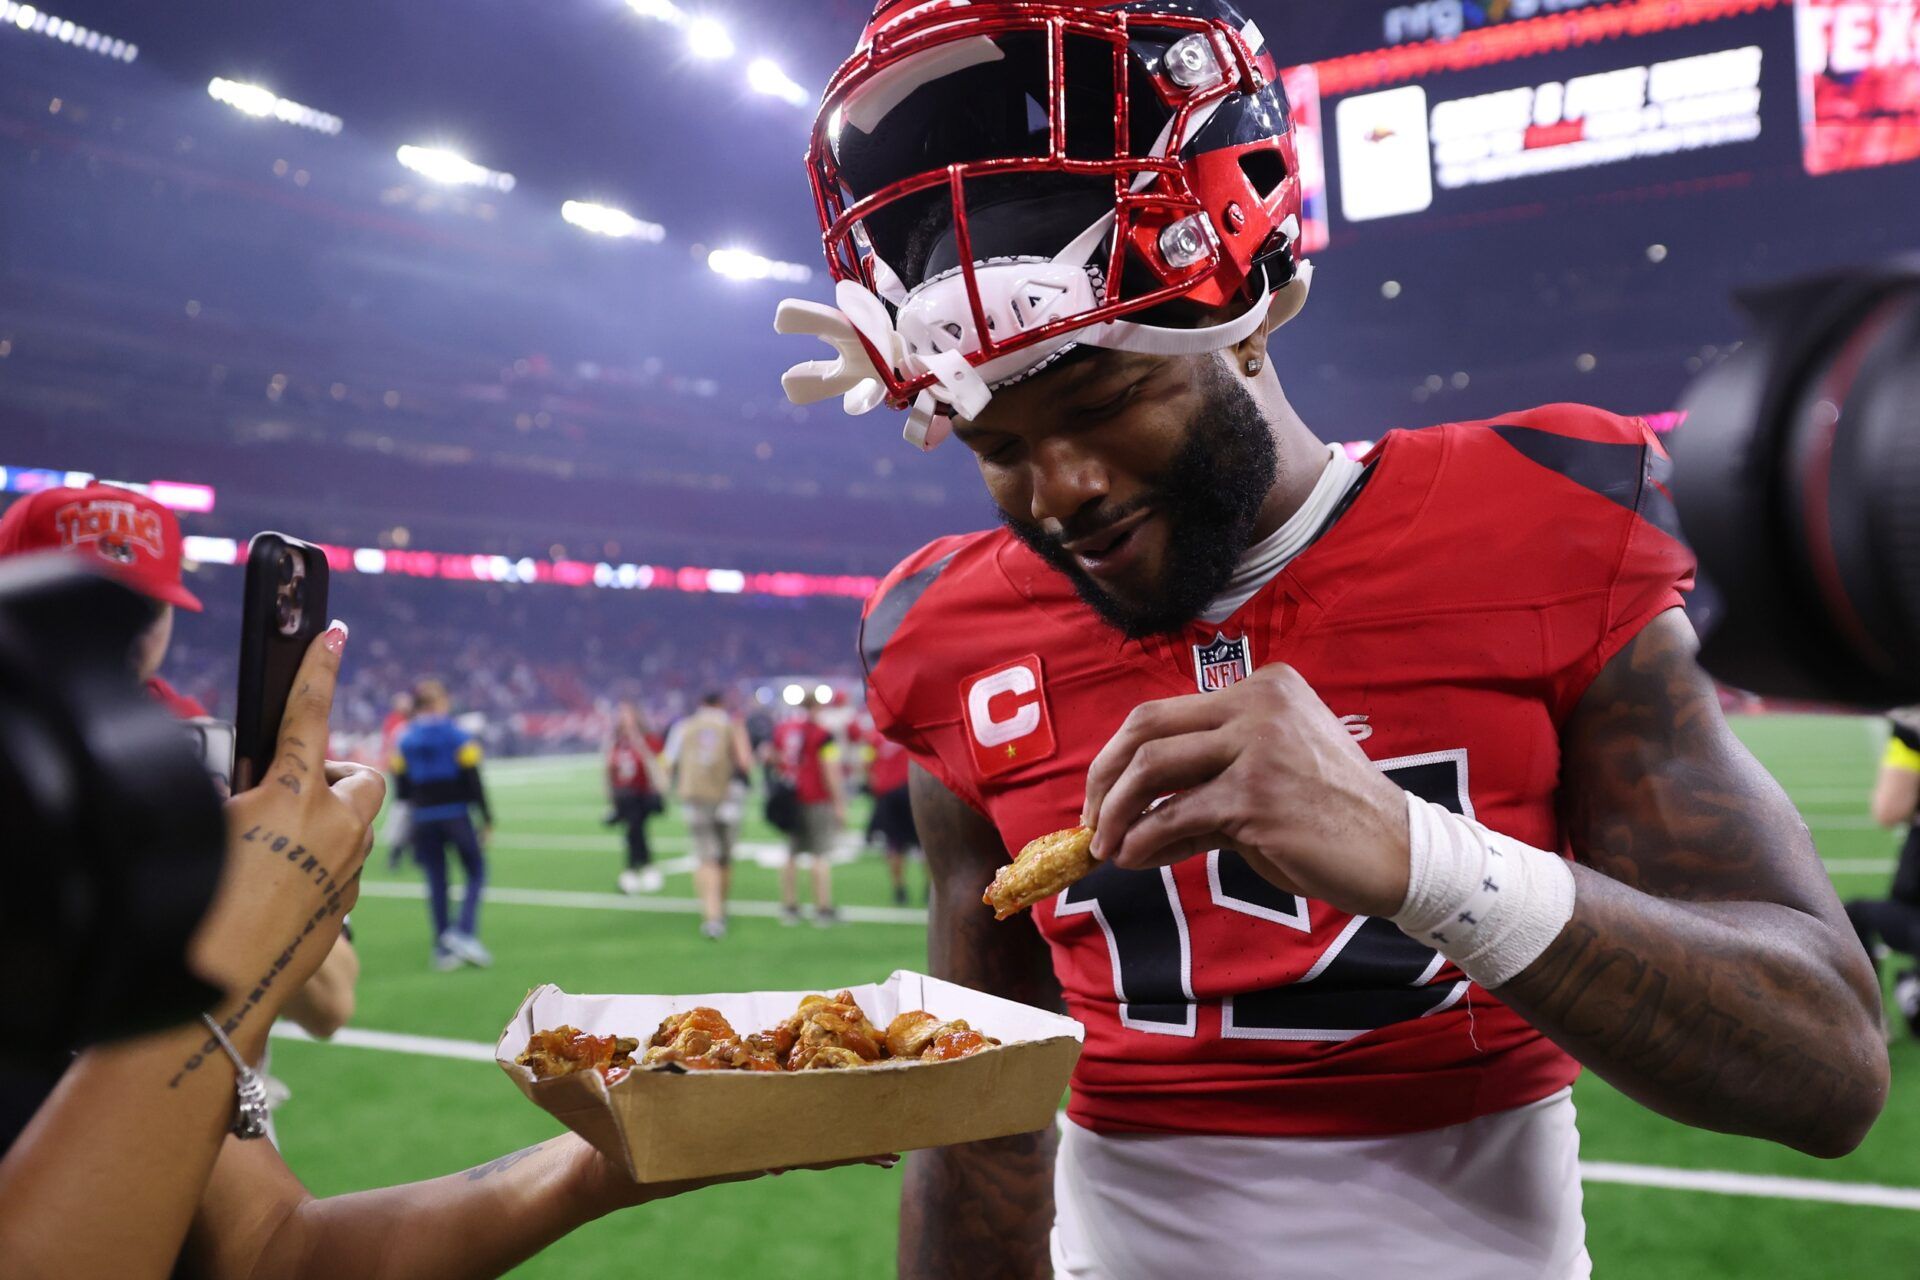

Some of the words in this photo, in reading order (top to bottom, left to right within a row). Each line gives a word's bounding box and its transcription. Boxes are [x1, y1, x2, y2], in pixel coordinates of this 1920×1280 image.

[1798, 1, 1920, 74] TEX
[968, 664, 1042, 749] C
[1205, 661, 1246, 689] NFL
